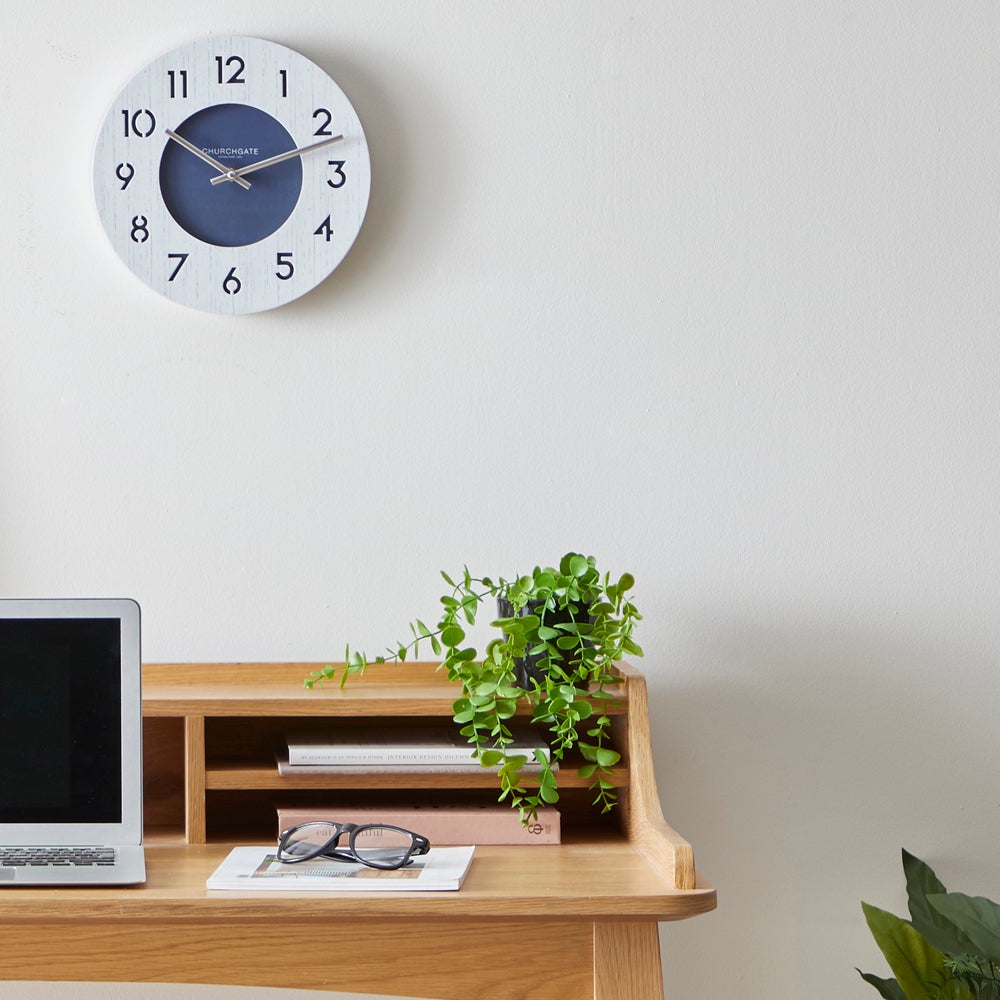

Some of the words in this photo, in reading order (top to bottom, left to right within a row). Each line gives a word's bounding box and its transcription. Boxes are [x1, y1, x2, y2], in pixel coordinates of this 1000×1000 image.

[215, 55, 245, 84] 12
[279, 69, 287, 97] 1
[167, 70, 188, 98] 11
[121, 109, 156, 138] 10
[312, 108, 332, 135] 2
[202, 147, 259, 156] CHURCHGATE
[115, 162, 135, 190] 9
[326, 160, 346, 189] 3
[130, 215, 149, 243] 8
[313, 214, 334, 242] 4
[167, 253, 189, 281] 7
[275, 252, 294, 280] 5
[222, 267, 242, 295] 6
